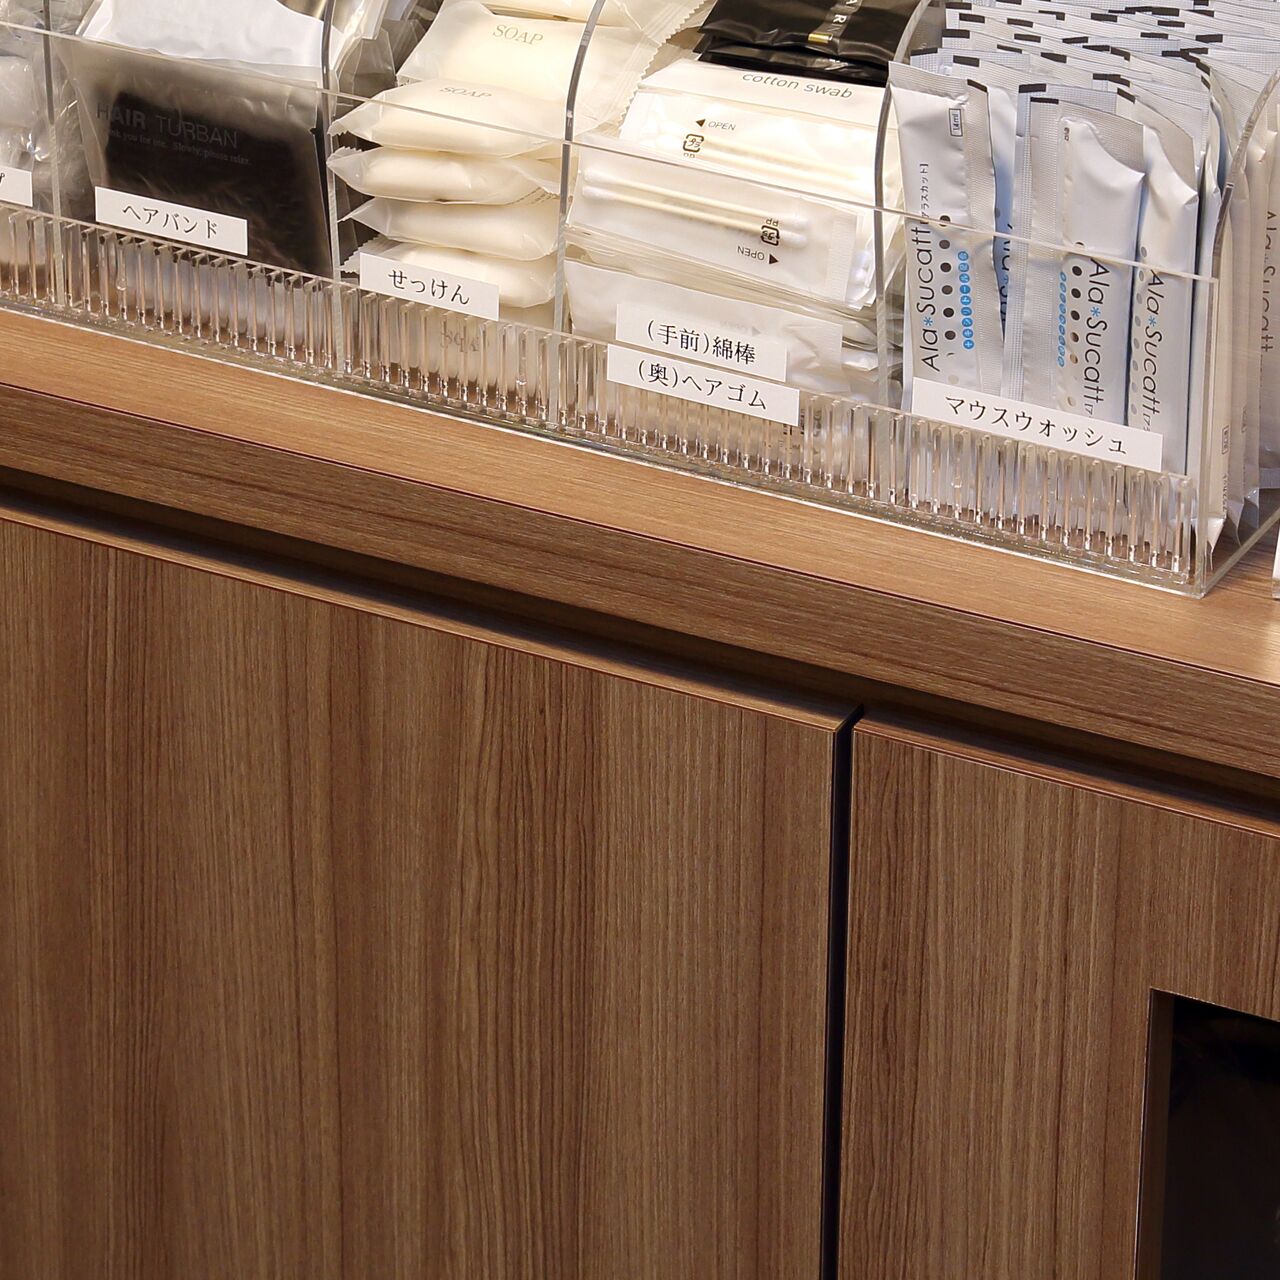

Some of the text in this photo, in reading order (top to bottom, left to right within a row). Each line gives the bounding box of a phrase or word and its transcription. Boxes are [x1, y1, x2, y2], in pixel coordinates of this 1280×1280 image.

[491, 23, 544, 46] SOAP
[439, 86, 492, 99] SOAP
[742, 73, 853, 99] cotton swab
[96, 101, 239, 149] HAIR TURBAN
[707, 120, 736, 131] OPEN
[122, 205, 218, 239] ヘアバンド
[737, 245, 765, 261] OPEN
[388, 269, 470, 305] せっけん
[647, 319, 756, 366] (手前)綿棒
[638, 359, 767, 410] (奥)ヘアゴム
[945, 395, 1127, 455] マウスウォッシュ
